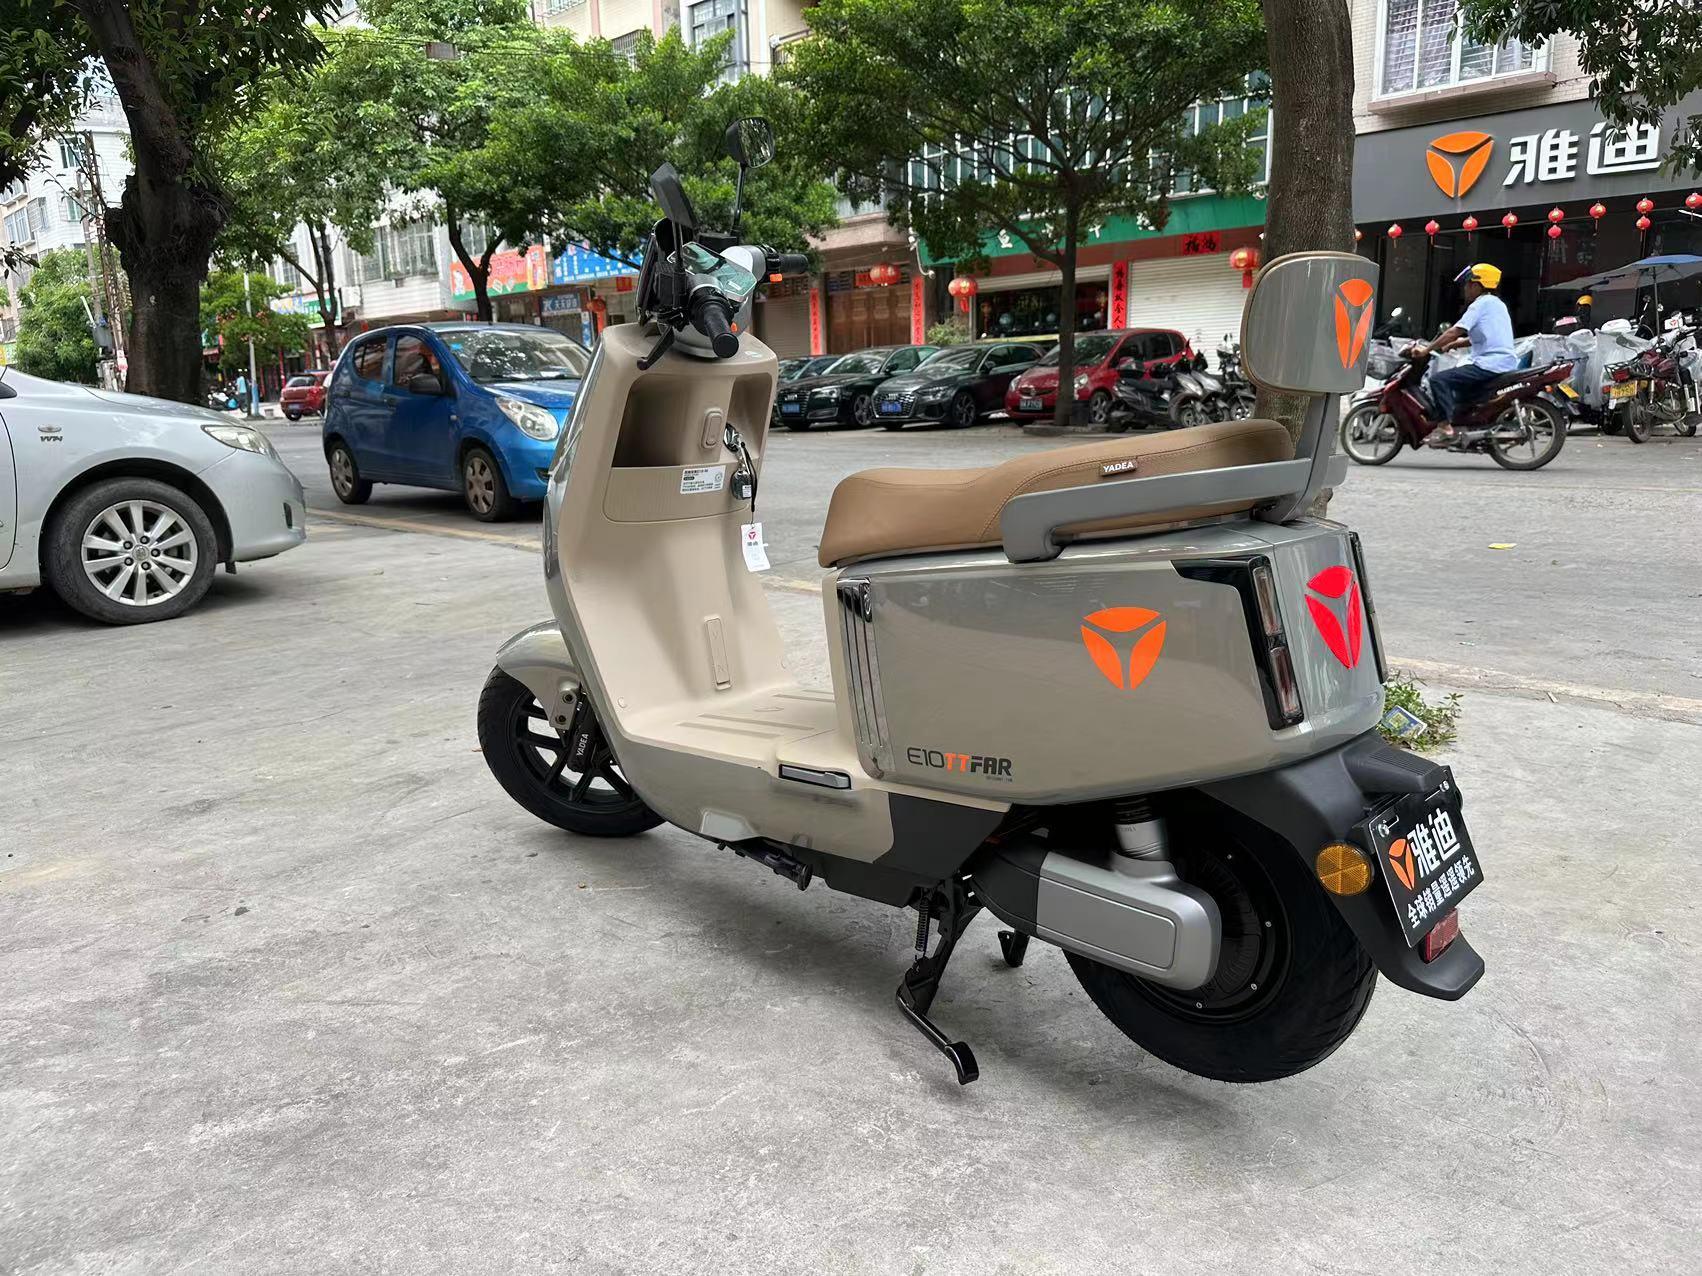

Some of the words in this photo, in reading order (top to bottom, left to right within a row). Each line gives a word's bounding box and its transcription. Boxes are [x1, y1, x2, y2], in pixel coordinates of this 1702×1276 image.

[1502, 118, 1661, 186] 雅迪
[1103, 461, 1134, 473] YADEA
[576, 733, 589, 756] YADEA
[1406, 807, 1461, 879] 雅迪
[1406, 854, 1475, 929] 全球销量遥遥领先
